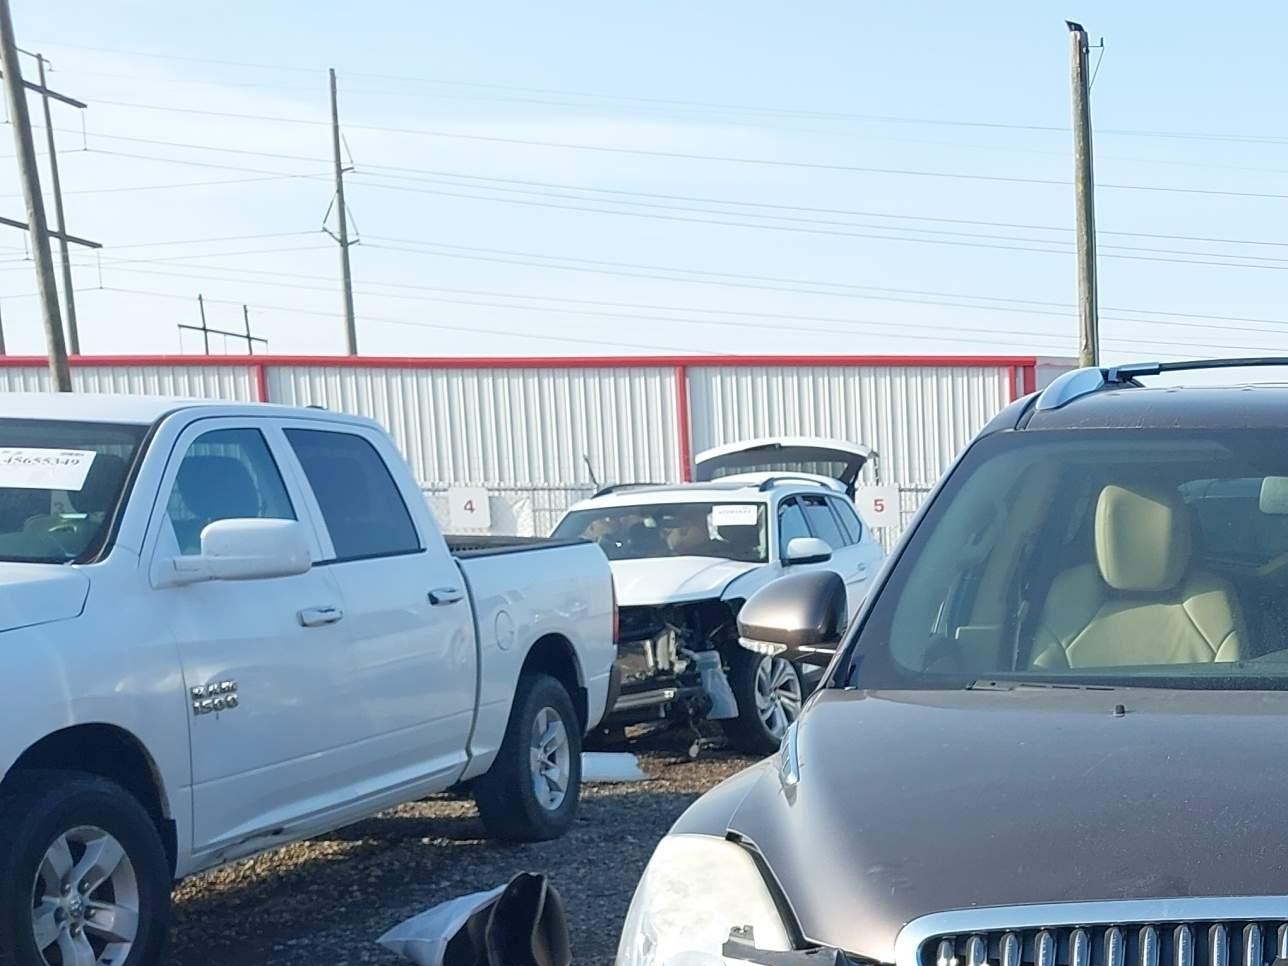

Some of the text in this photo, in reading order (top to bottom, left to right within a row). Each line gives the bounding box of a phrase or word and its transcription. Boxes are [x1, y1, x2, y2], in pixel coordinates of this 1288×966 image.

[463, 500, 475, 513] 4
[873, 499, 885, 512] 5
[191, 680, 238, 700] RAM
[193, 694, 239, 717] 1500
